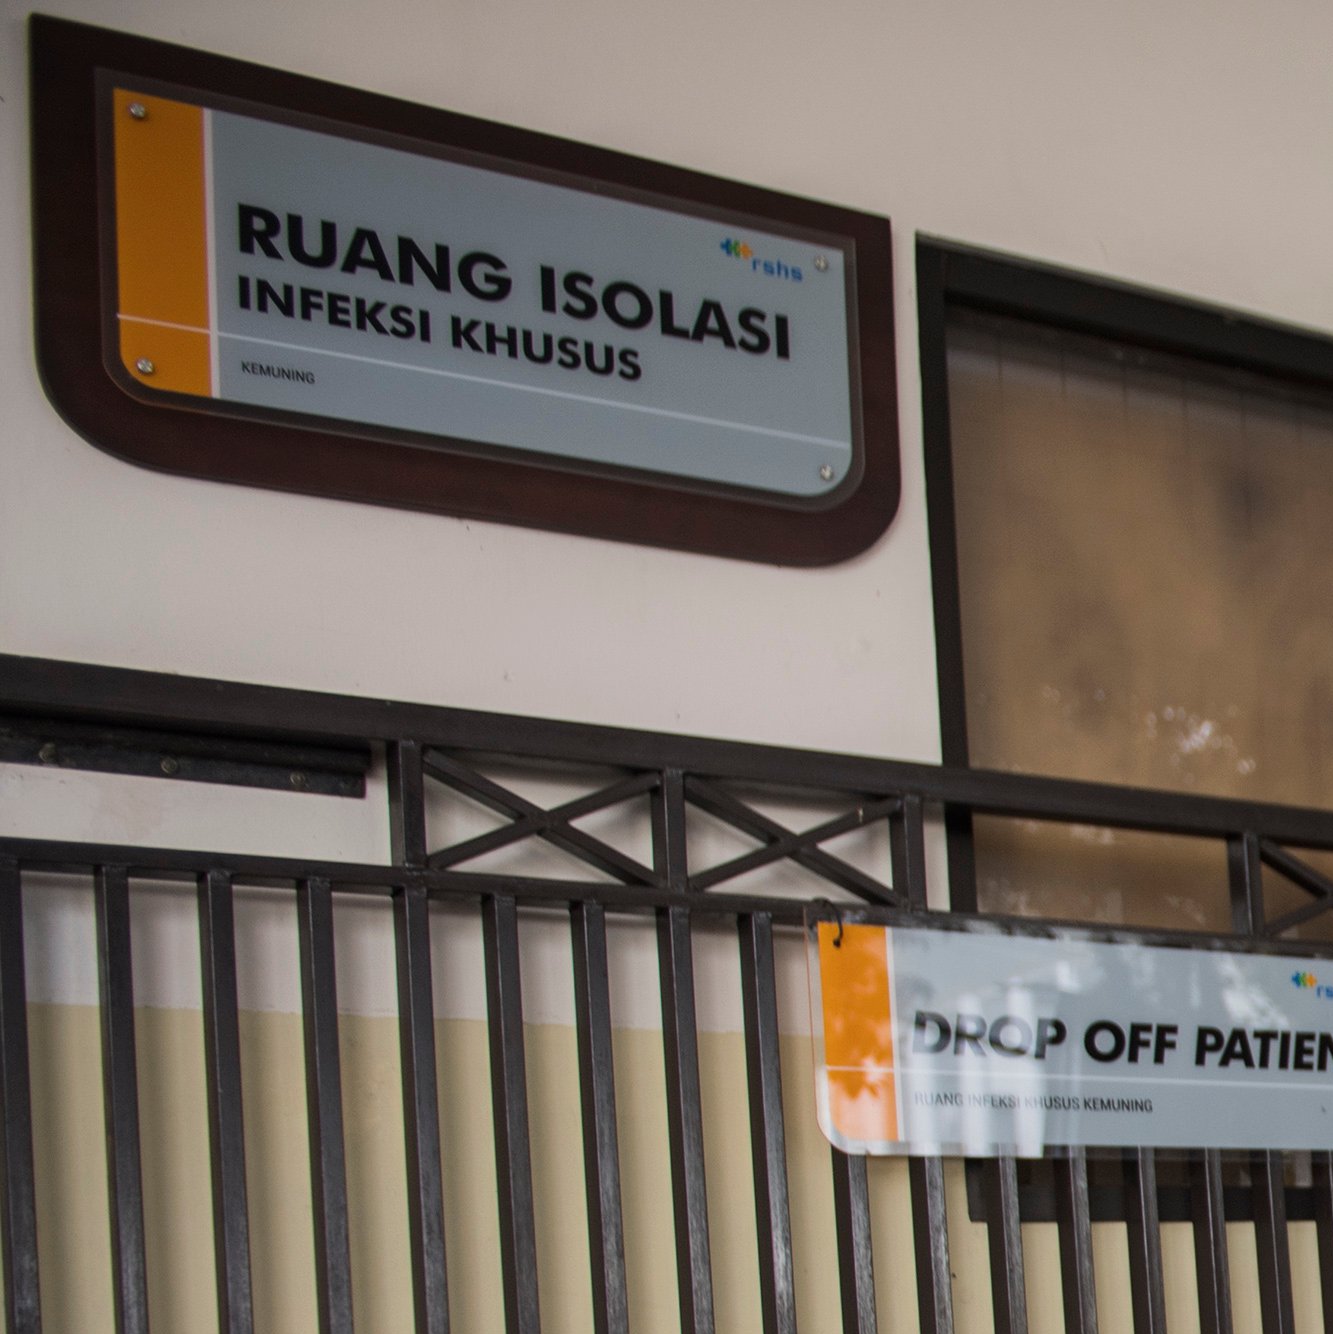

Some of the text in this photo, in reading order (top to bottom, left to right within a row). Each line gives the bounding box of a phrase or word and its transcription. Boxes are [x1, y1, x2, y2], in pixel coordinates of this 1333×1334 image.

[237, 202, 791, 361] RUANG ISOLASI
[752, 258, 803, 282] rshs
[237, 275, 642, 381] INFEKSI KHUSUS
[241, 360, 316, 385] KEMUNING
[912, 1010, 1067, 1060] DROP
[1083, 1020, 1178, 1065] OFF
[914, 1091, 1154, 1113] RUANG INFEKSI KHUSUS KEMUNING
